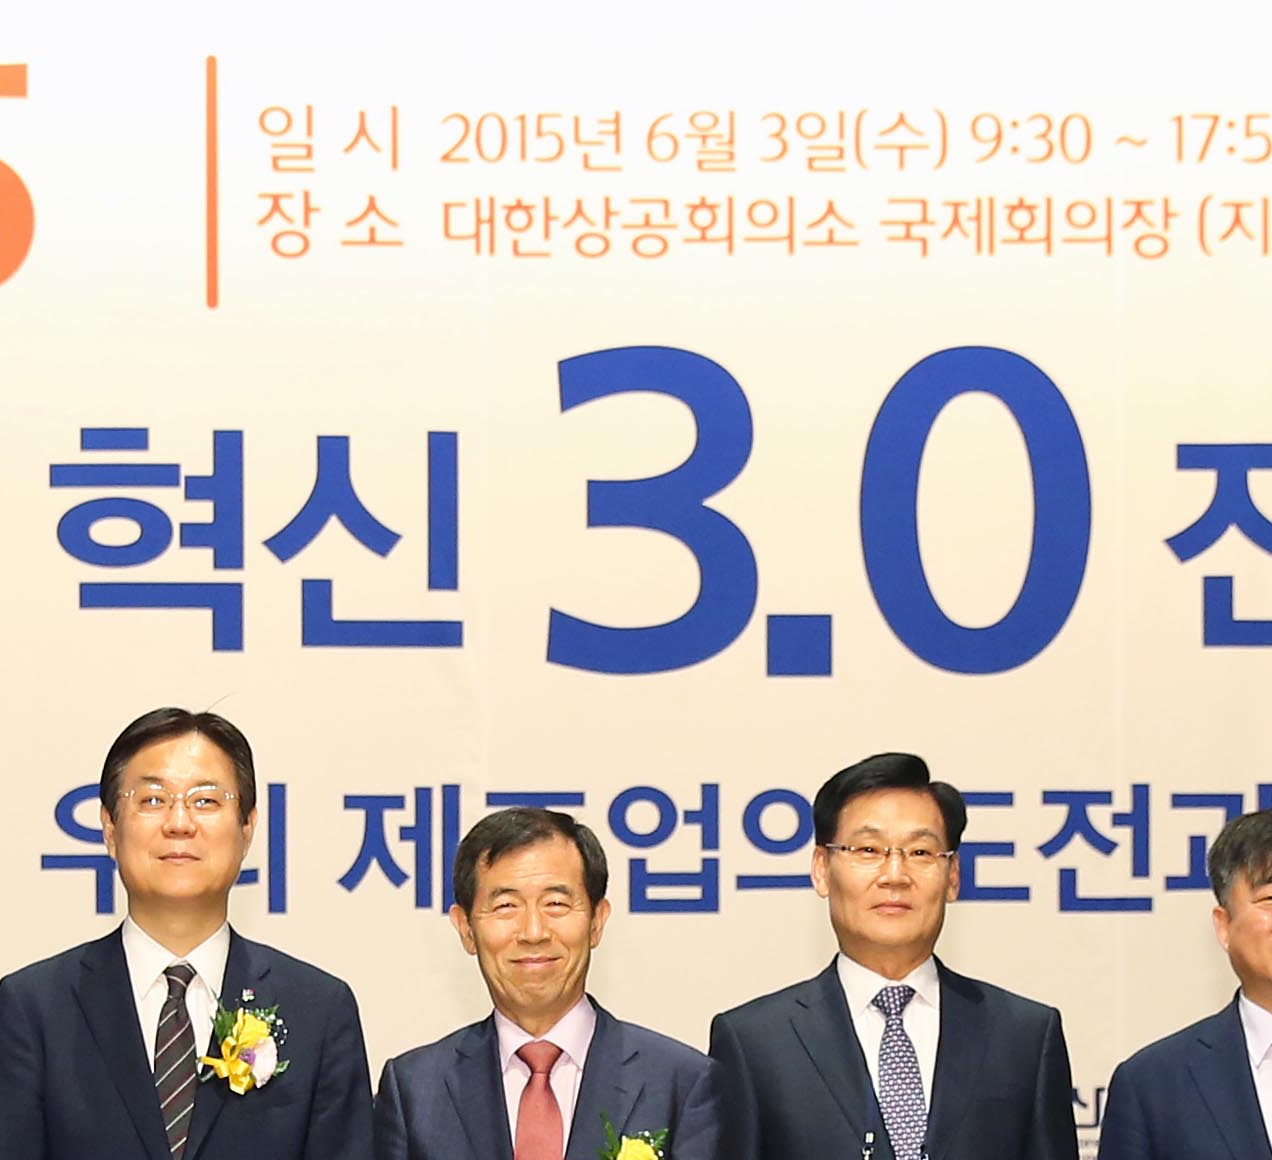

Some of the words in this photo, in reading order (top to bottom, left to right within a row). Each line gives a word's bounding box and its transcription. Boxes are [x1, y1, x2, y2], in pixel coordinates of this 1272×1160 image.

[257, 103, 316, 174] 일
[342, 104, 400, 172] 시
[439, 110, 623, 173] 2015년
[645, 110, 737, 173] 6월
[759, 107, 949, 173] 3일(수)
[969, 111, 1094, 165] 9:30
[256, 188, 322, 260] 장
[339, 193, 405, 248] 소
[441, 194, 862, 260] 대한상공회의소
[879, 194, 1181, 260] 국제회의장
[49, 427, 464, 652] 혁신
[547, 345, 1092, 677] 3.0
[337, 784, 816, 914] 제업의
